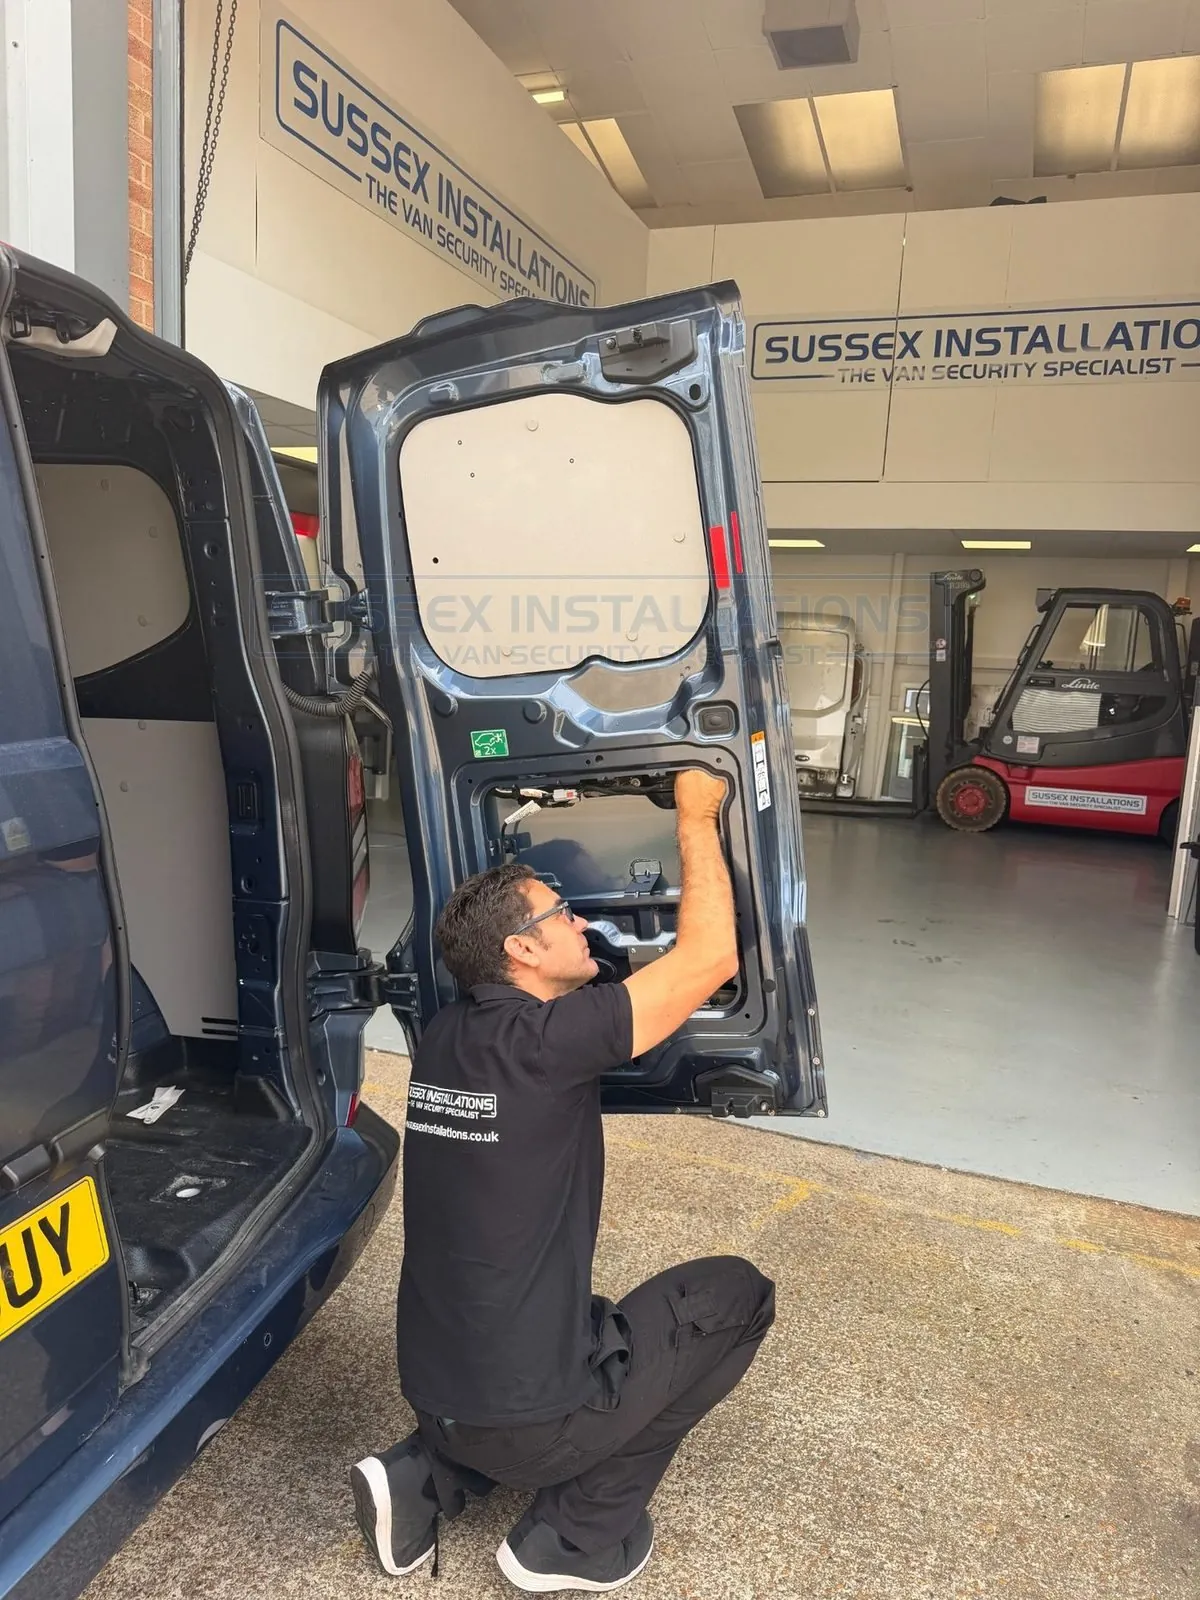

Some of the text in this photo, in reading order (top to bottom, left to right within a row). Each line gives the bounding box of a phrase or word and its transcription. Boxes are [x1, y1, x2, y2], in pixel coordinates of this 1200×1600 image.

[293, 60, 590, 306] SUSSEX INSTALLATIONS
[365, 172, 397, 215] THE
[402, 198, 433, 240] VAN
[437, 225, 497, 283] SECURITY
[765, 329, 924, 364] SUSSEX
[838, 357, 1177, 384] THE VAN SECURITY SPECIALIST
[1061, 677, 1100, 690] Linde
[1032, 791, 1140, 808] SUSSEX INSTALLATIONS
[426, 1089, 494, 1111] INSTALLATIONS
[445, 1106, 480, 1119] SPECIALIST
[0, 1202, 72, 1318] UY
